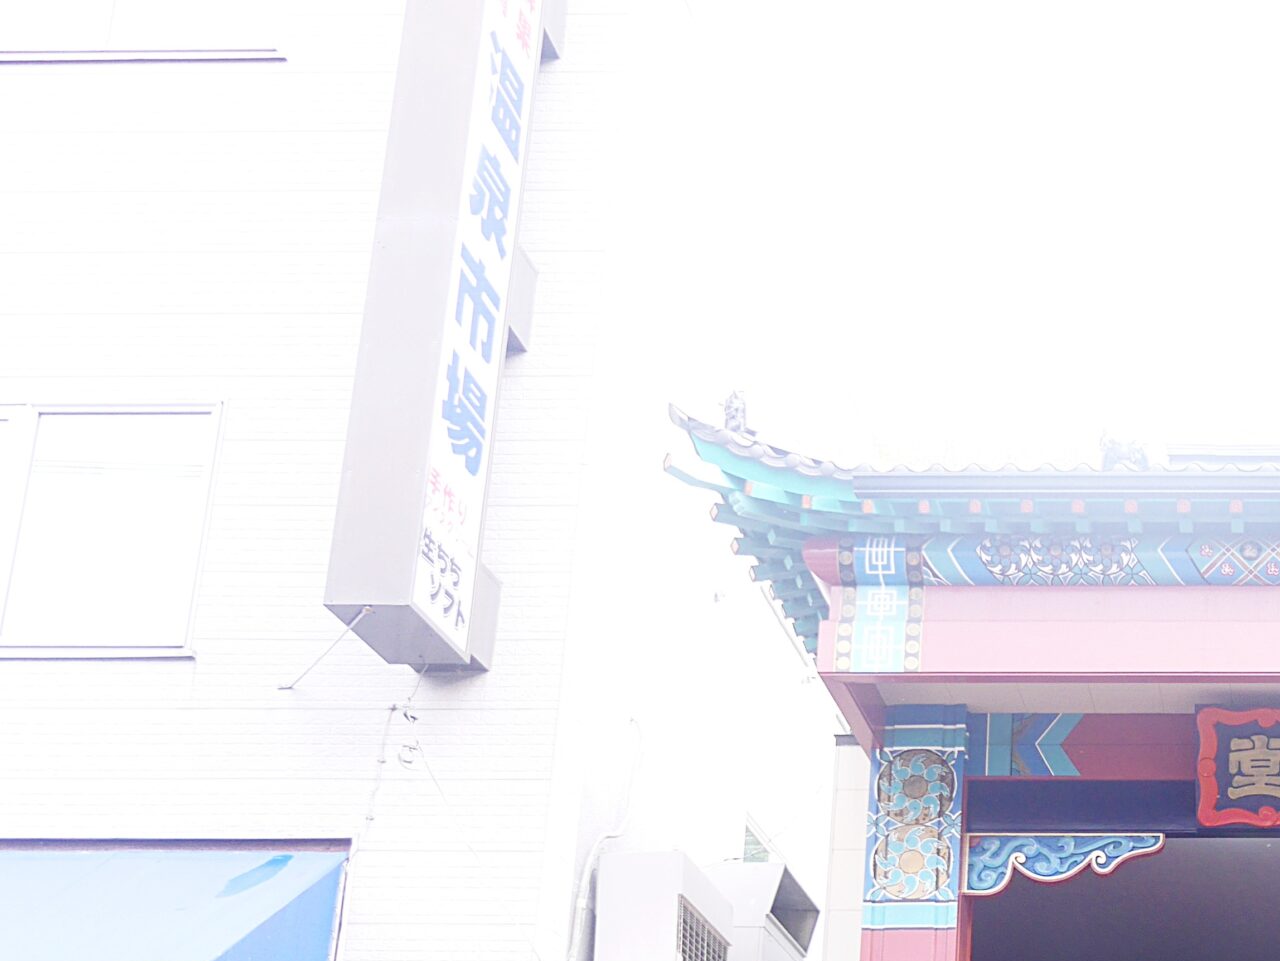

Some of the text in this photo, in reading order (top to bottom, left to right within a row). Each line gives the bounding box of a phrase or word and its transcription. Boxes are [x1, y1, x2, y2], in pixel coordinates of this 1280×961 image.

[442, 30, 526, 478] 温泉市場
[421, 527, 463, 589] 生ちち
[429, 573, 466, 629] ソフト
